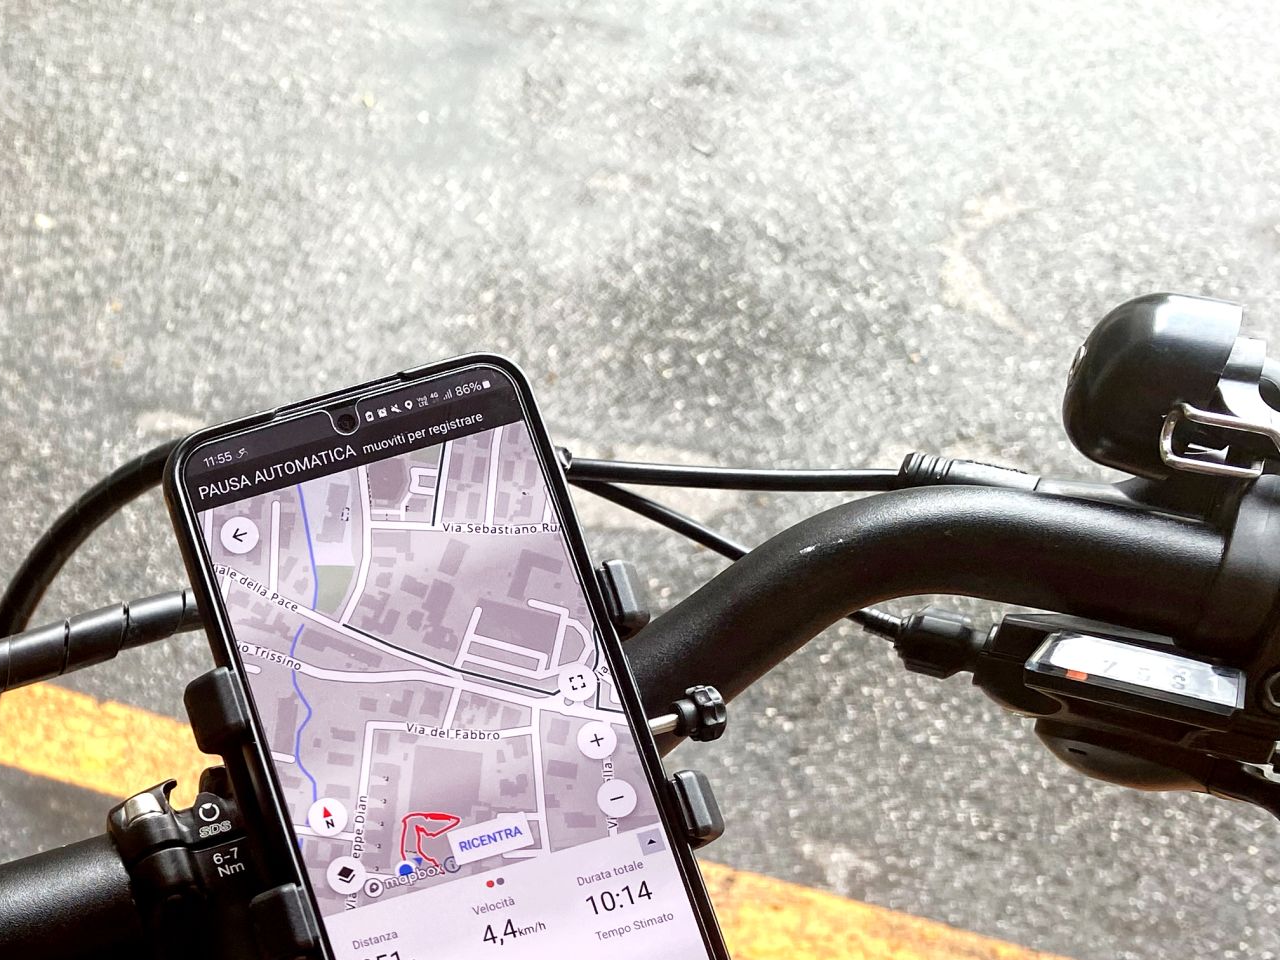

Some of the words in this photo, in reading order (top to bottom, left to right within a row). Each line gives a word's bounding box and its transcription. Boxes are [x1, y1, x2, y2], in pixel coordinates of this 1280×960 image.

[455, 381, 482, 397] 86%
[198, 474, 252, 500] PAUSA
[255, 444, 357, 485] AUTOMATICA
[362, 432, 406, 455] muoviti
[408, 429, 426, 444] per
[428, 413, 484, 436] registrare
[203, 451, 233, 467] 11:55
[443, 523, 461, 533] Via
[467, 523, 537, 534] Sebastiano
[240, 576, 268, 597] della
[270, 592, 298, 612] Pace
[255, 646, 302, 670] Trissino
[407, 722, 425, 734] Via
[430, 727, 450, 738] del
[455, 730, 500, 740] Fabbro
[199, 820, 232, 838] SDS
[325, 818, 335, 829] N
[458, 826, 523, 852] RICENTRA
[213, 847, 239, 865] 6-7
[217, 862, 245, 877] Nm
[384, 864, 444, 890] mapbox
[576, 869, 612, 886] Durata
[613, 860, 644, 876] totale
[472, 896, 515, 916] Velocità
[585, 880, 653, 915] 10:14
[595, 924, 631, 941] Tempo
[633, 913, 674, 930] Stimato
[352, 931, 399, 950] Distanza
